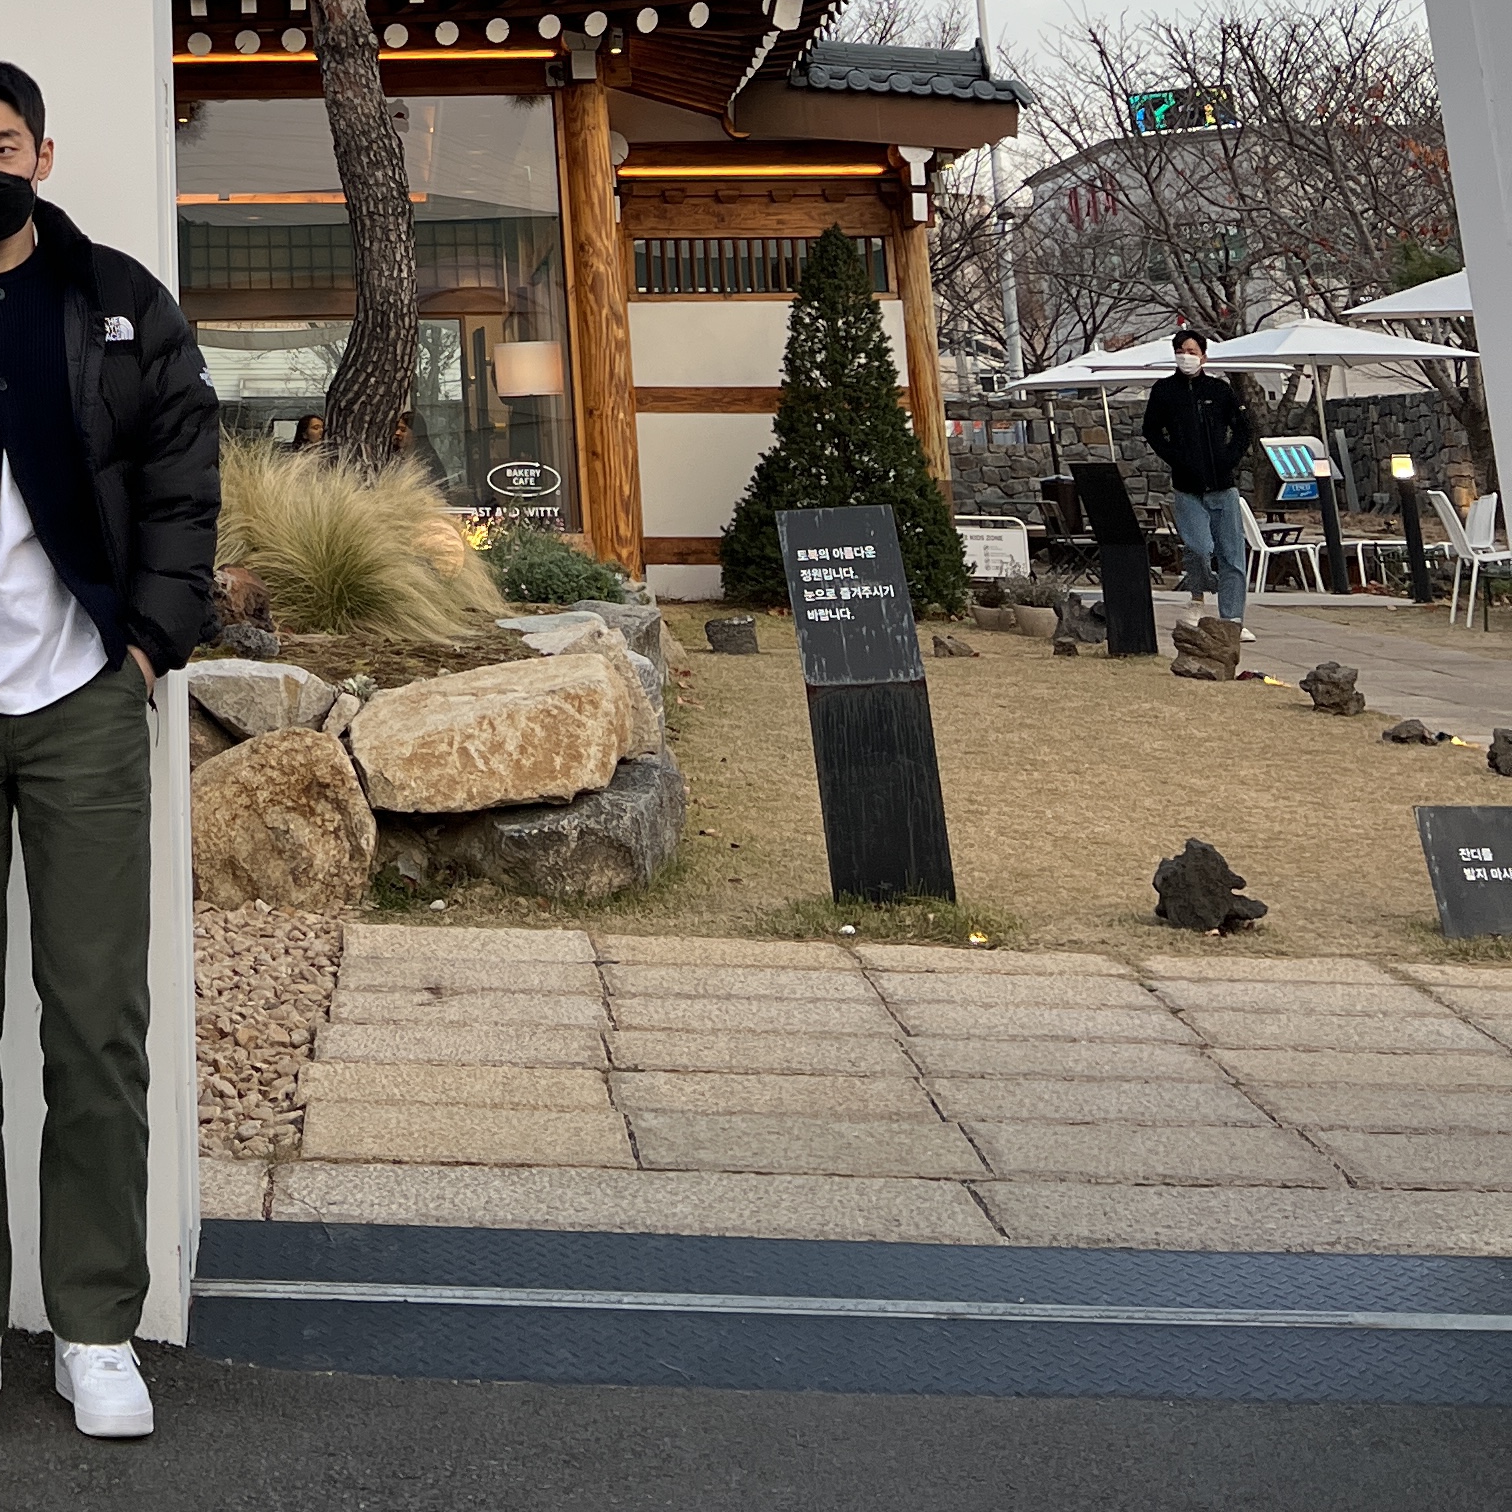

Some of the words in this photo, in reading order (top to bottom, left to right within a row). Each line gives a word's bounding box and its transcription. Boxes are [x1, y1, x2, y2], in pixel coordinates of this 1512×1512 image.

[506, 468, 541, 478] BAKERY
[512, 477, 536, 486] CAFE
[796, 547, 830, 562] 토북의
[832, 545, 877, 560] 아름다운
[800, 566, 859, 582] 정원입니다.
[803, 588, 838, 602] 눈으로
[806, 607, 856, 622] 바랍니다.
